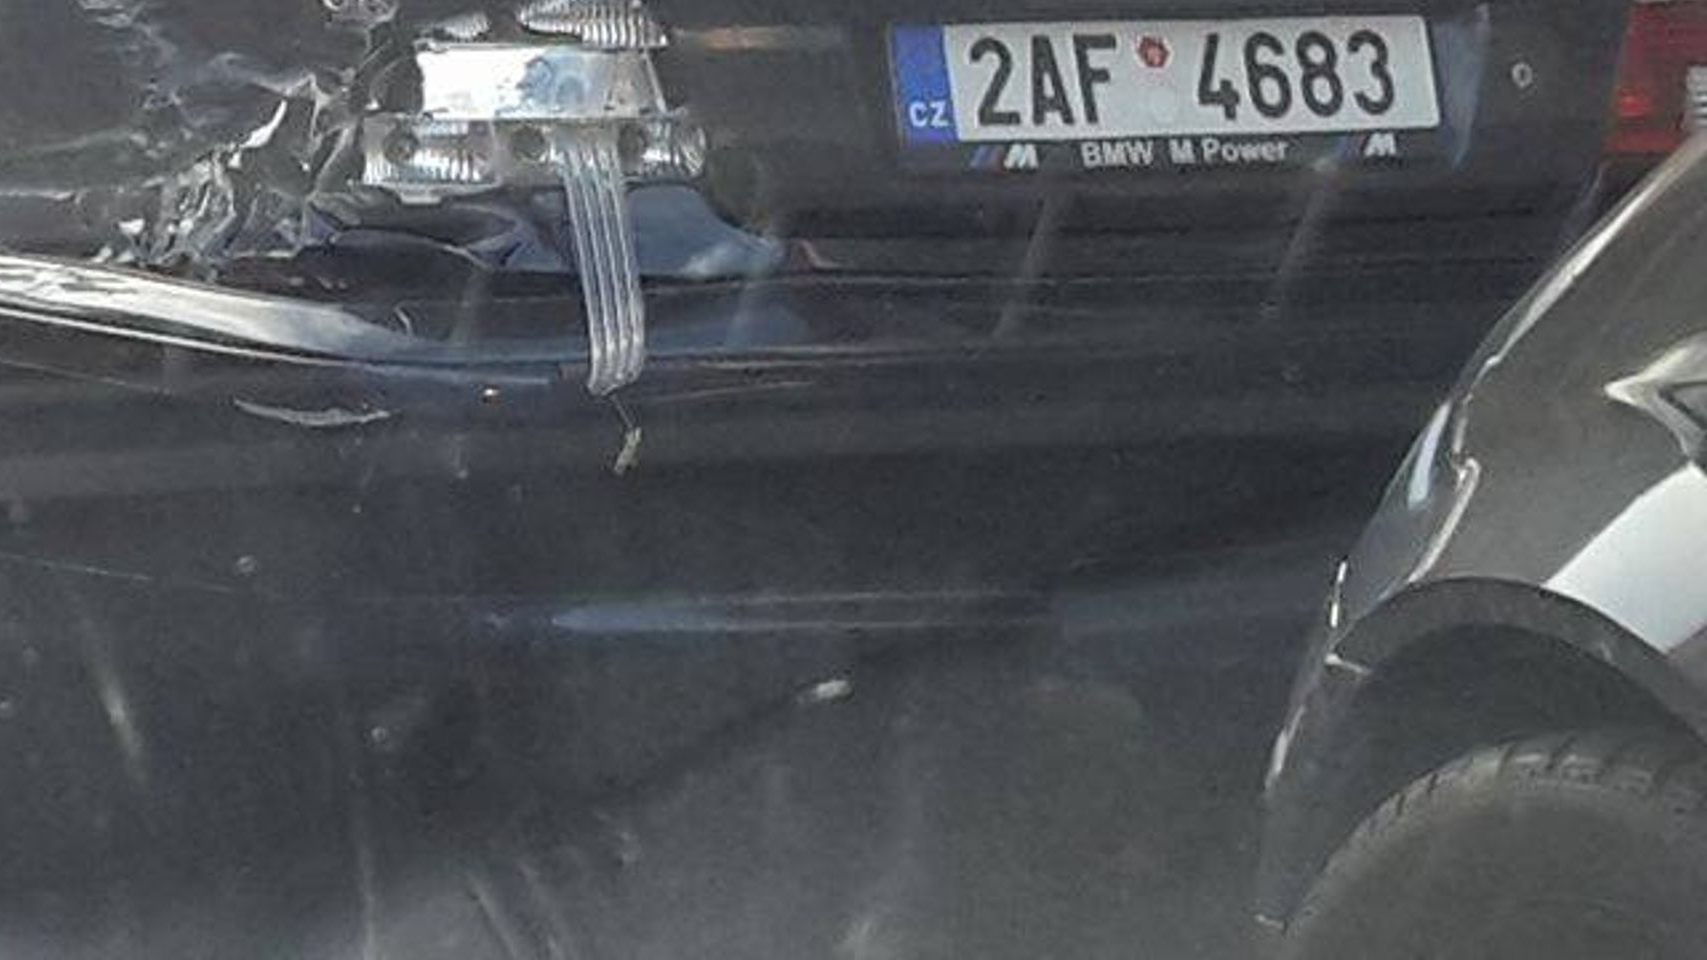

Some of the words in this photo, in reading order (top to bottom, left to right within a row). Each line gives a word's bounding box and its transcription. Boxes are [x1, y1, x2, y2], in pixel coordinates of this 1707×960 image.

[969, 36, 1117, 127] 2AF
[1197, 29, 1395, 120] 4683
[908, 101, 949, 128] CZ
[1081, 140, 1155, 169] BMW
[1169, 139, 1194, 165] M
[1202, 137, 1291, 164] Power
